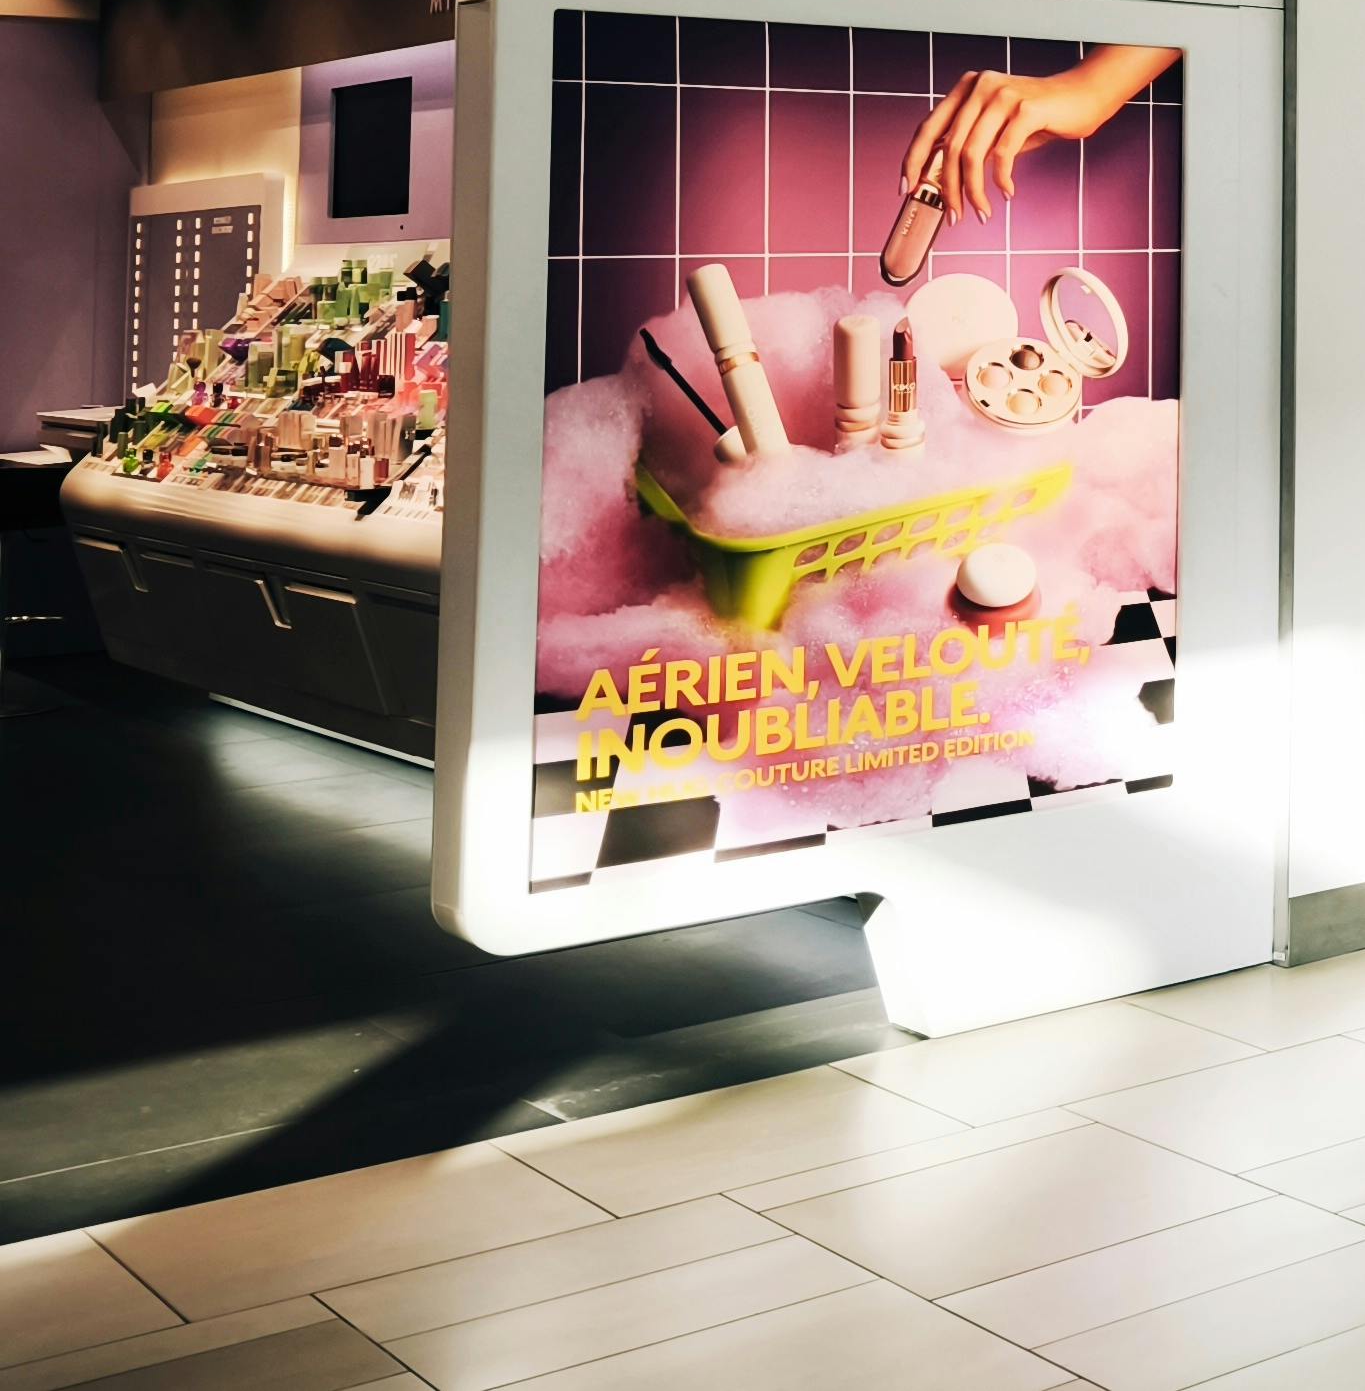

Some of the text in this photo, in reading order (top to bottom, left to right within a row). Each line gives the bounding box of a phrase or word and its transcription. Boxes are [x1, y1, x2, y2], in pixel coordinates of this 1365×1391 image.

[574, 602, 1092, 722] AÉRIEN, VELOUTÉ,
[575, 680, 991, 782] INOUBLIABLE.
[718, 756, 841, 793] COUTURE
[845, 740, 940, 774] LIMITED
[944, 729, 1036, 759] EDITION
